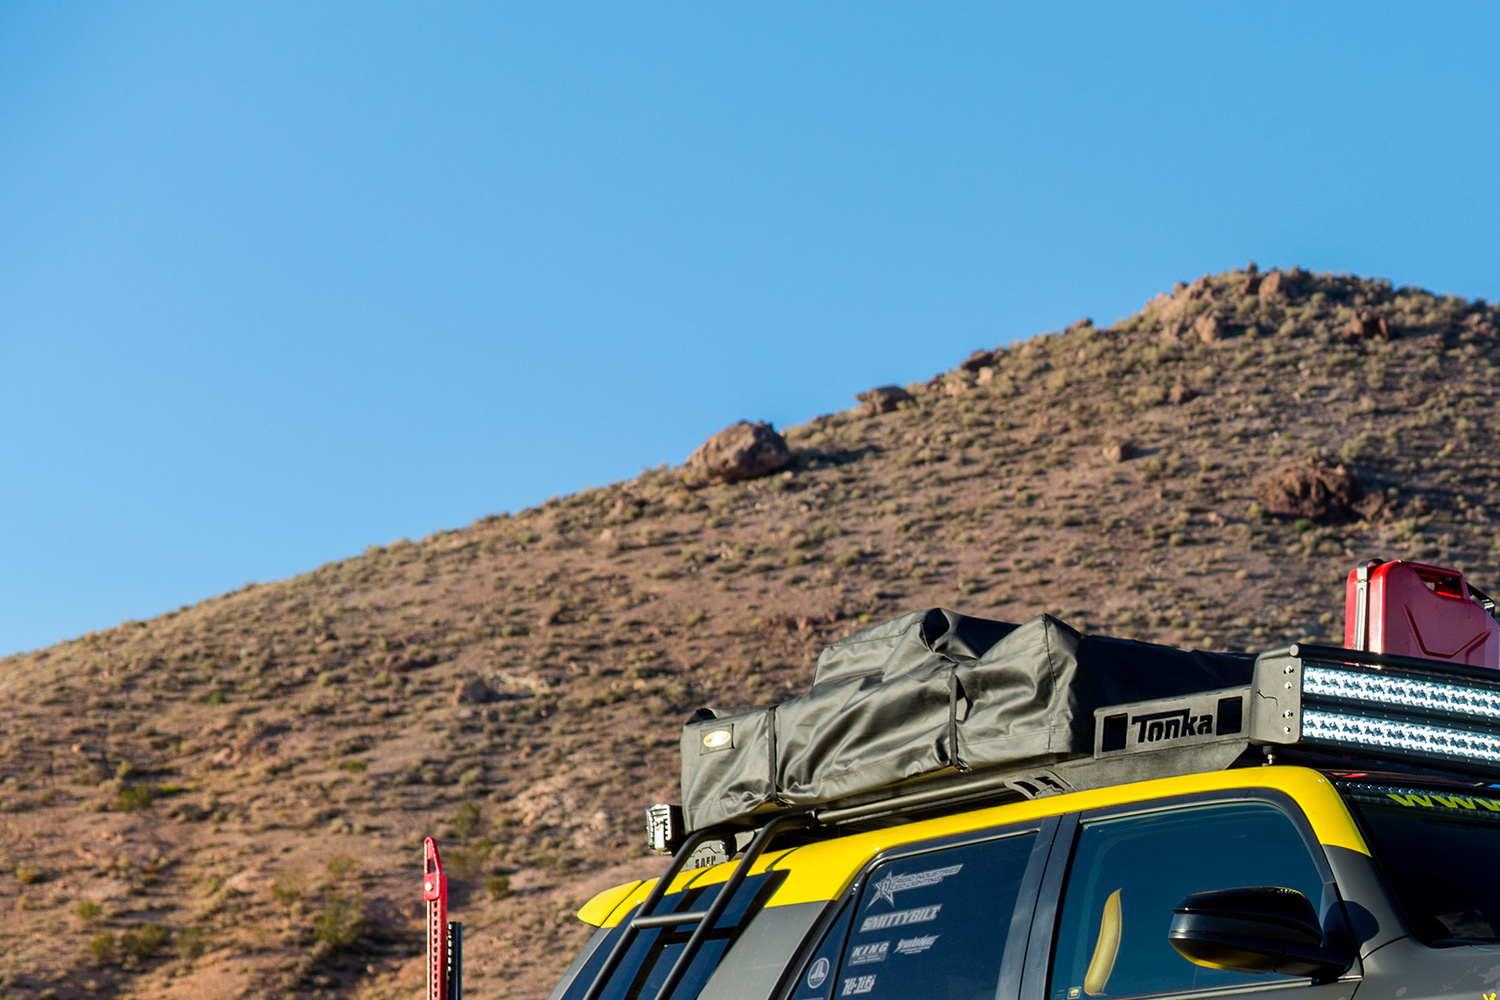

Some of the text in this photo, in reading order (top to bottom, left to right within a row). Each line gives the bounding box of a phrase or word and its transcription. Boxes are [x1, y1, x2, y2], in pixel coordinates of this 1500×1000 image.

[1132, 708, 1213, 743] Tonka
[861, 904, 943, 932] SMITTYBILT
[852, 942, 890, 957] KING
